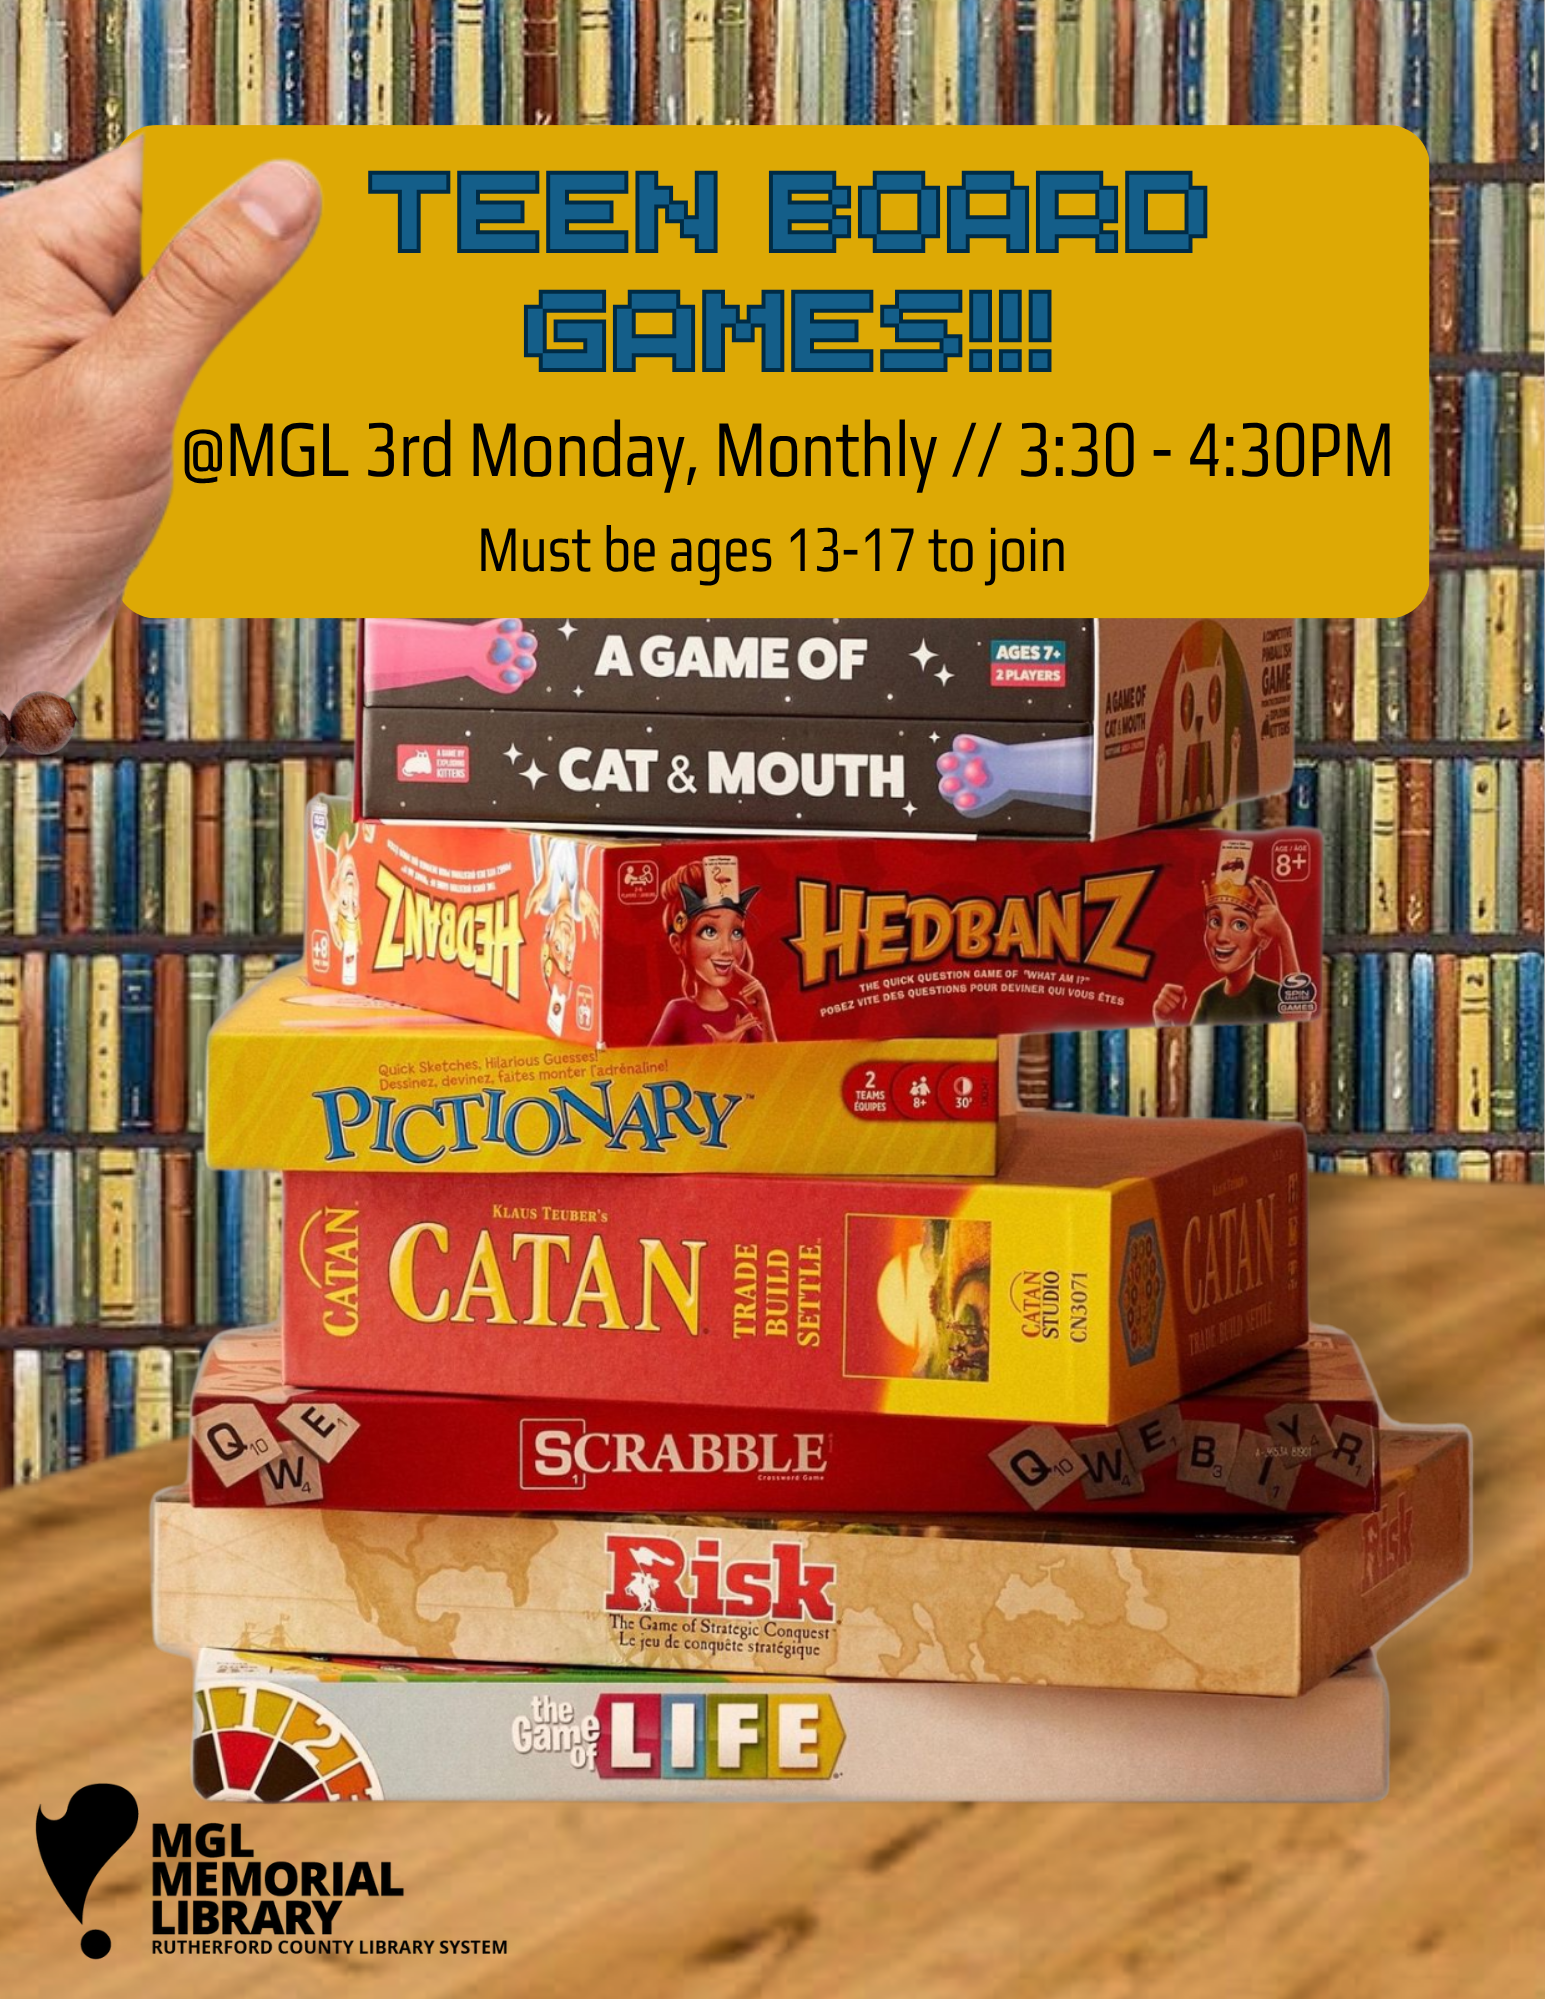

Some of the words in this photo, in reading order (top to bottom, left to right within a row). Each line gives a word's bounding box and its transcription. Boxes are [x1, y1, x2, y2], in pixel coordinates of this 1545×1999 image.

[594, 635, 633, 676] A
[639, 635, 789, 680] GAME
[797, 637, 868, 681] OF
[996, 644, 1039, 660] AGES
[1043, 645, 1061, 660] 7+
[995, 669, 1003, 681] 2
[1004, 669, 1061, 682] PLAYERS
[1262, 662, 1291, 696] GAME
[1105, 694, 1112, 714] A
[1113, 688, 1135, 712] GAME
[1135, 684, 1147, 706] OF
[1105, 718, 1116, 739] CAT
[1122, 712, 1146, 734] MOUTH
[436, 768, 466, 779] KITTENS
[558, 747, 659, 792] CAT
[666, 754, 697, 794] &
[708, 751, 904, 798] MOUTH
[1276, 853, 1307, 877] 8+
[372, 860, 526, 1002] HEDBANZ
[789, 865, 1163, 990] HEDBANZ
[859, 981, 880, 993] THE
[883, 975, 914, 989] QUICK
[918, 970, 970, 983] QUESTION
[974, 970, 1002, 978] GAME
[1005, 970, 1018, 978] OF
[1023, 970, 1056, 981] "WHAT
[1059, 973, 1074, 983] AM
[1076, 975, 1090, 984] I?"
[820, 1000, 855, 1017] POSEZ
[857, 995, 880, 1007] VITE
[883, 991, 905, 1002] DES
[908, 984, 967, 998] QUESTIONS
[970, 983, 998, 993] POUR
[1001, 983, 1044, 994] DEVINER
[1048, 985, 1065, 996] QUI
[1068, 988, 1095, 1000] VOUS
[1097, 992, 1124, 1006] ÊTES
[1280, 1003, 1314, 1011] GAMES
[379, 1063, 415, 1077] Quick
[419, 1059, 482, 1074] Sketches,
[485, 1055, 540, 1070] Hilarious
[544, 1050, 598, 1065] Guesses!
[379, 1076, 438, 1091] Dessinez,
[442, 1073, 495, 1088] devinez,
[498, 1070, 535, 1083] faites
[539, 1068, 586, 1081] monter
[590, 1059, 668, 1077] l'adrénaline!
[865, 1071, 876, 1088] 2
[854, 1101, 886, 1111] ÉQUIPES
[855, 1091, 885, 1100] TEAMS
[913, 1097, 927, 1108] 8+
[313, 1081, 742, 1164] PICTIONARY
[492, 1204, 537, 1220] KLAUS
[1183, 1192, 1276, 1315] CATAN
[323, 1206, 360, 1337] CATAN
[388, 1221, 707, 1336] CATAN
[732, 1243, 757, 1339] TRADE
[766, 1248, 789, 1338] BUILD
[797, 1243, 822, 1347] SETTLE
[1022, 1270, 1041, 1338] CATAN
[1042, 1270, 1061, 1340] STUDIO
[1070, 1271, 1088, 1343] CN3071
[300, 1406, 336, 1438] E
[1138, 1419, 1167, 1453] E
[1277, 1413, 1301, 1446] Y
[207, 1422, 248, 1461] Q
[250, 1438, 269, 1456] 10
[535, 1430, 828, 1476] SCRABBLE
[1190, 1436, 1216, 1468] B
[1332, 1432, 1363, 1466] R
[265, 1456, 304, 1490] W
[1010, 1449, 1052, 1487] Q
[1052, 1458, 1074, 1478] 10
[1082, 1449, 1122, 1483] W
[604, 1533, 837, 1624] Risk
[609, 1614, 635, 1630] The
[639, 1616, 678, 1632] Game
[682, 1618, 698, 1633] of
[700, 1619, 759, 1639] Strategic
[764, 1621, 829, 1641] Conquest
[620, 1631, 635, 1646] Le
[640, 1633, 660, 1650] jeu
[665, 1632, 680, 1649] de
[684, 1638, 743, 1656] conquête
[748, 1640, 820, 1660] stratégique
[530, 1695, 573, 1724] the
[512, 1713, 600, 1753] Game
[611, 1702, 819, 1769] LIFE
[570, 1742, 597, 1771] of
